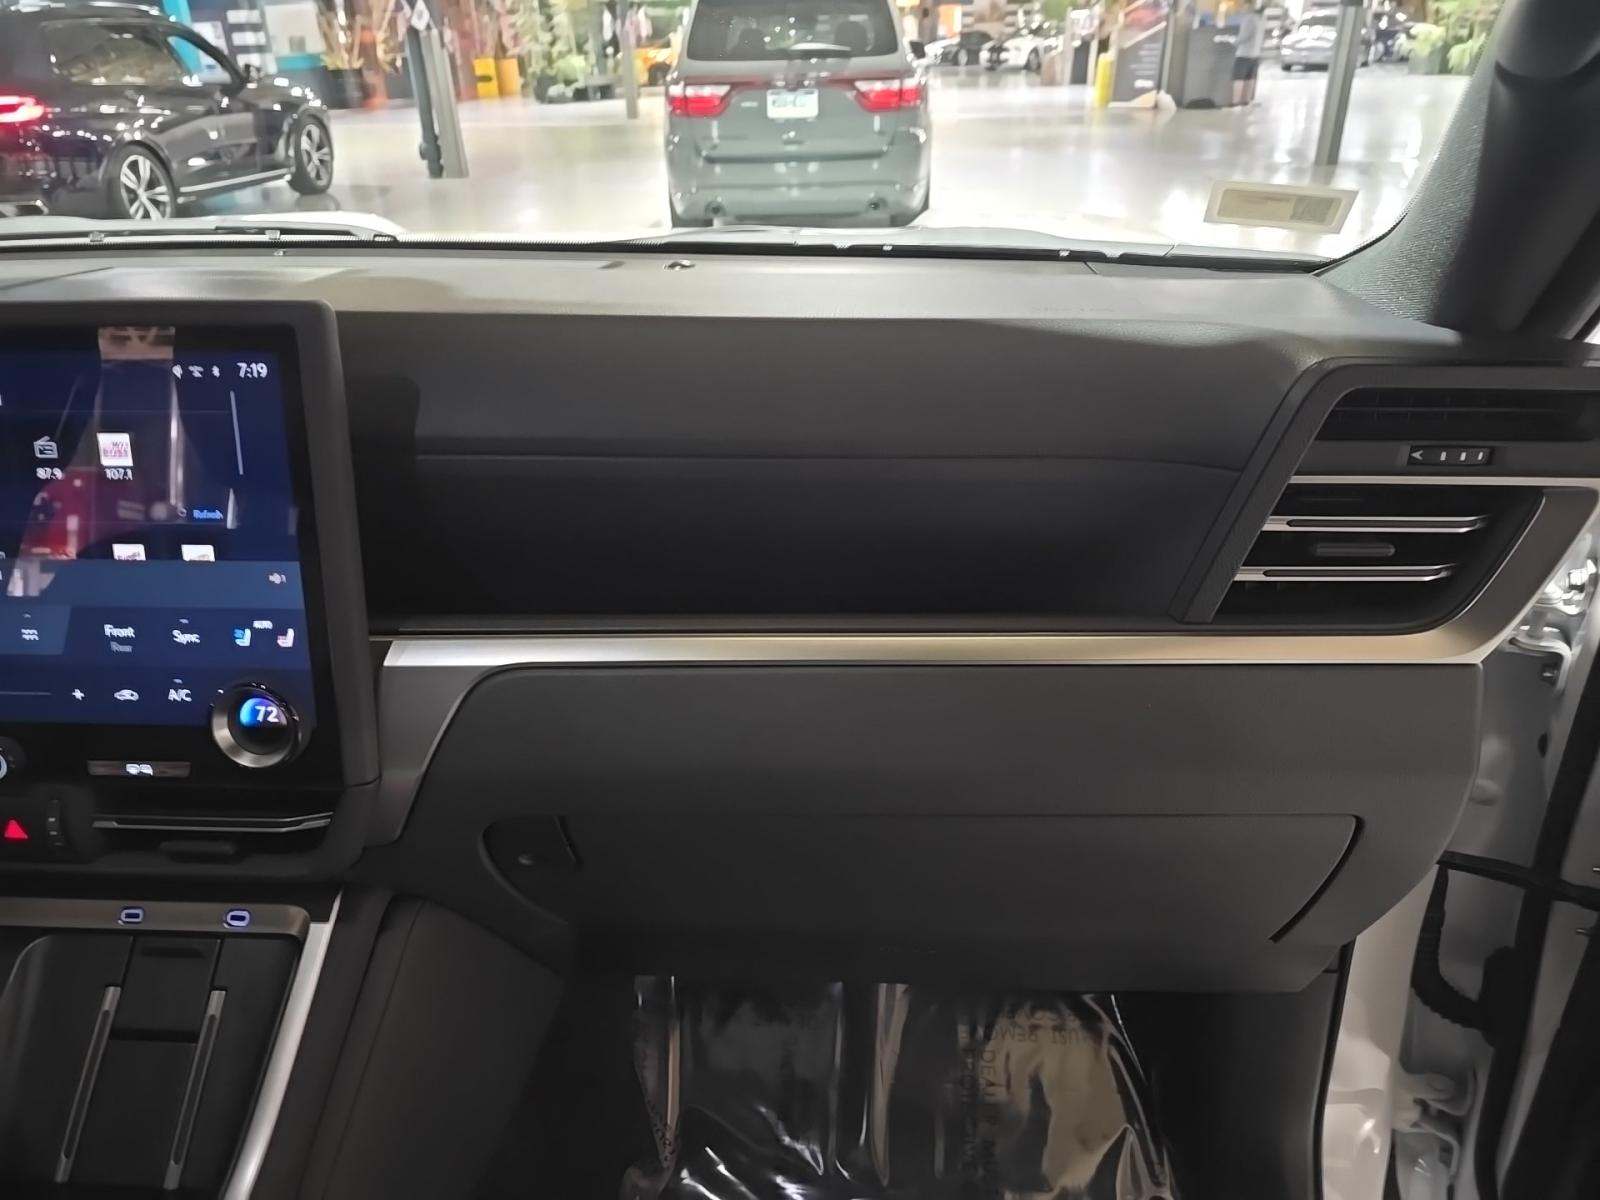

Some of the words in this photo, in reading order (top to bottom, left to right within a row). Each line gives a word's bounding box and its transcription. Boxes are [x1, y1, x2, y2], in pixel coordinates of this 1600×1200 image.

[237, 362, 268, 378] 7:19
[36, 467, 63, 480] 87.9
[104, 468, 134, 480] 107.1
[103, 624, 136, 639] Front
[173, 631, 200, 644] Sync
[169, 689, 192, 702] A/C
[255, 705, 279, 722] 72
